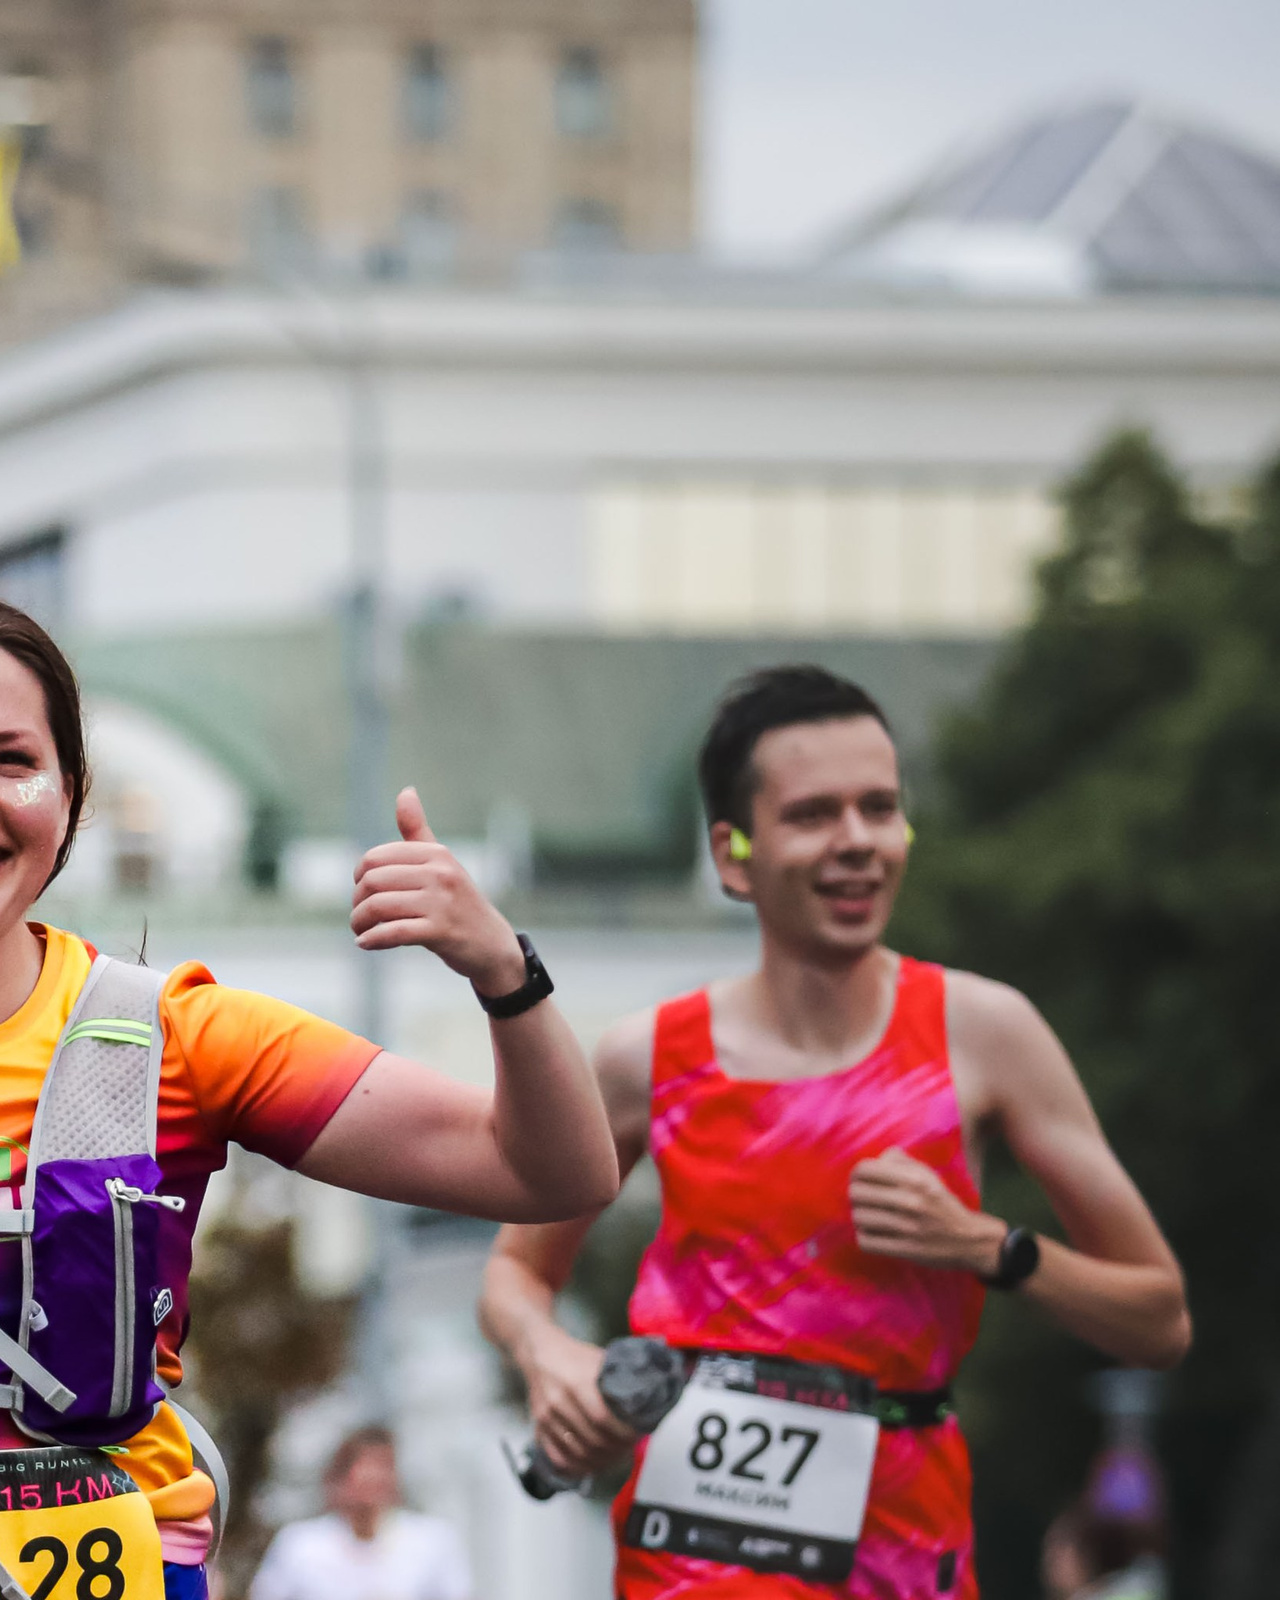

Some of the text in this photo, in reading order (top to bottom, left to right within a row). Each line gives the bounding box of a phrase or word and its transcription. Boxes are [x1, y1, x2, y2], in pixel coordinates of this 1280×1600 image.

[689, 1414, 821, 1486] 827
[0, 1484, 43, 1511] 15
[641, 1510, 671, 1548] D
